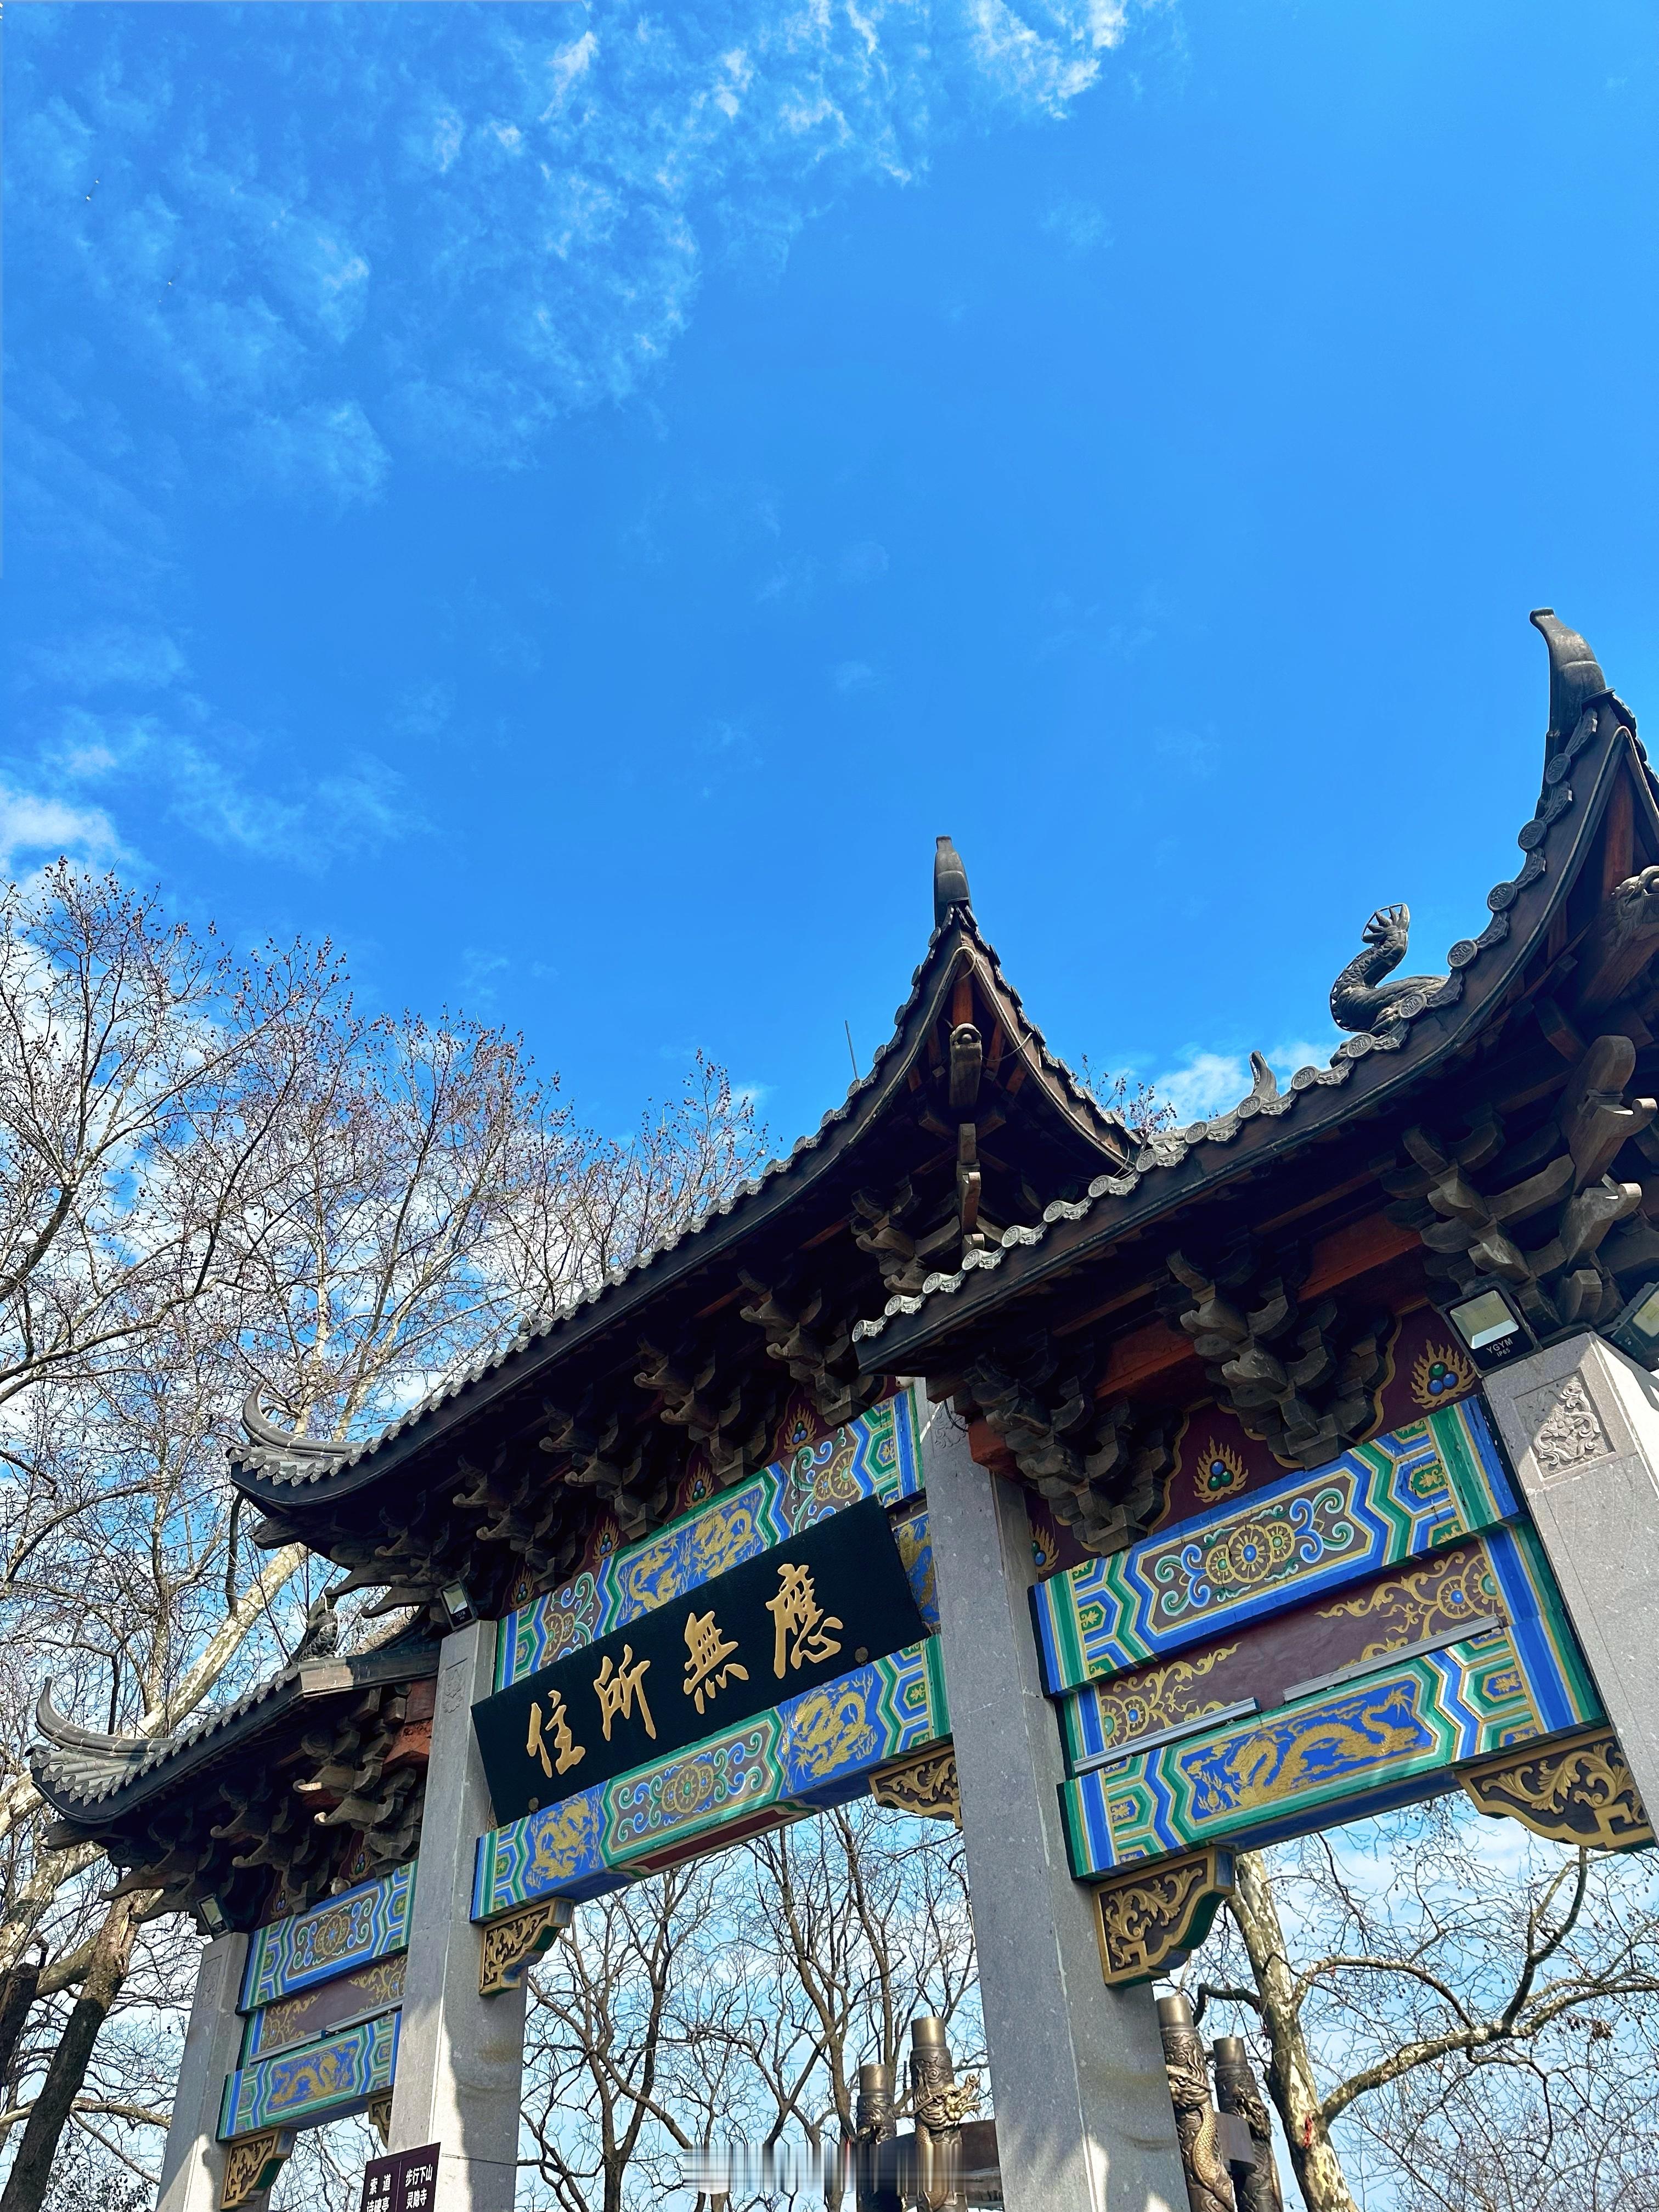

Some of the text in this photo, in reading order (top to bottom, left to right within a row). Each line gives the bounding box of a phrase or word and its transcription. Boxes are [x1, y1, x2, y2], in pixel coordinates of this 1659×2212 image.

[1486, 1338, 1514, 1354] YGYM
[1496, 1347, 1510, 1358] IP65
[369, 2173, 391, 2196] 索道
[405, 2164, 433, 2187] 步行下山
[406, 2187, 427, 2210] 灵隐寺
